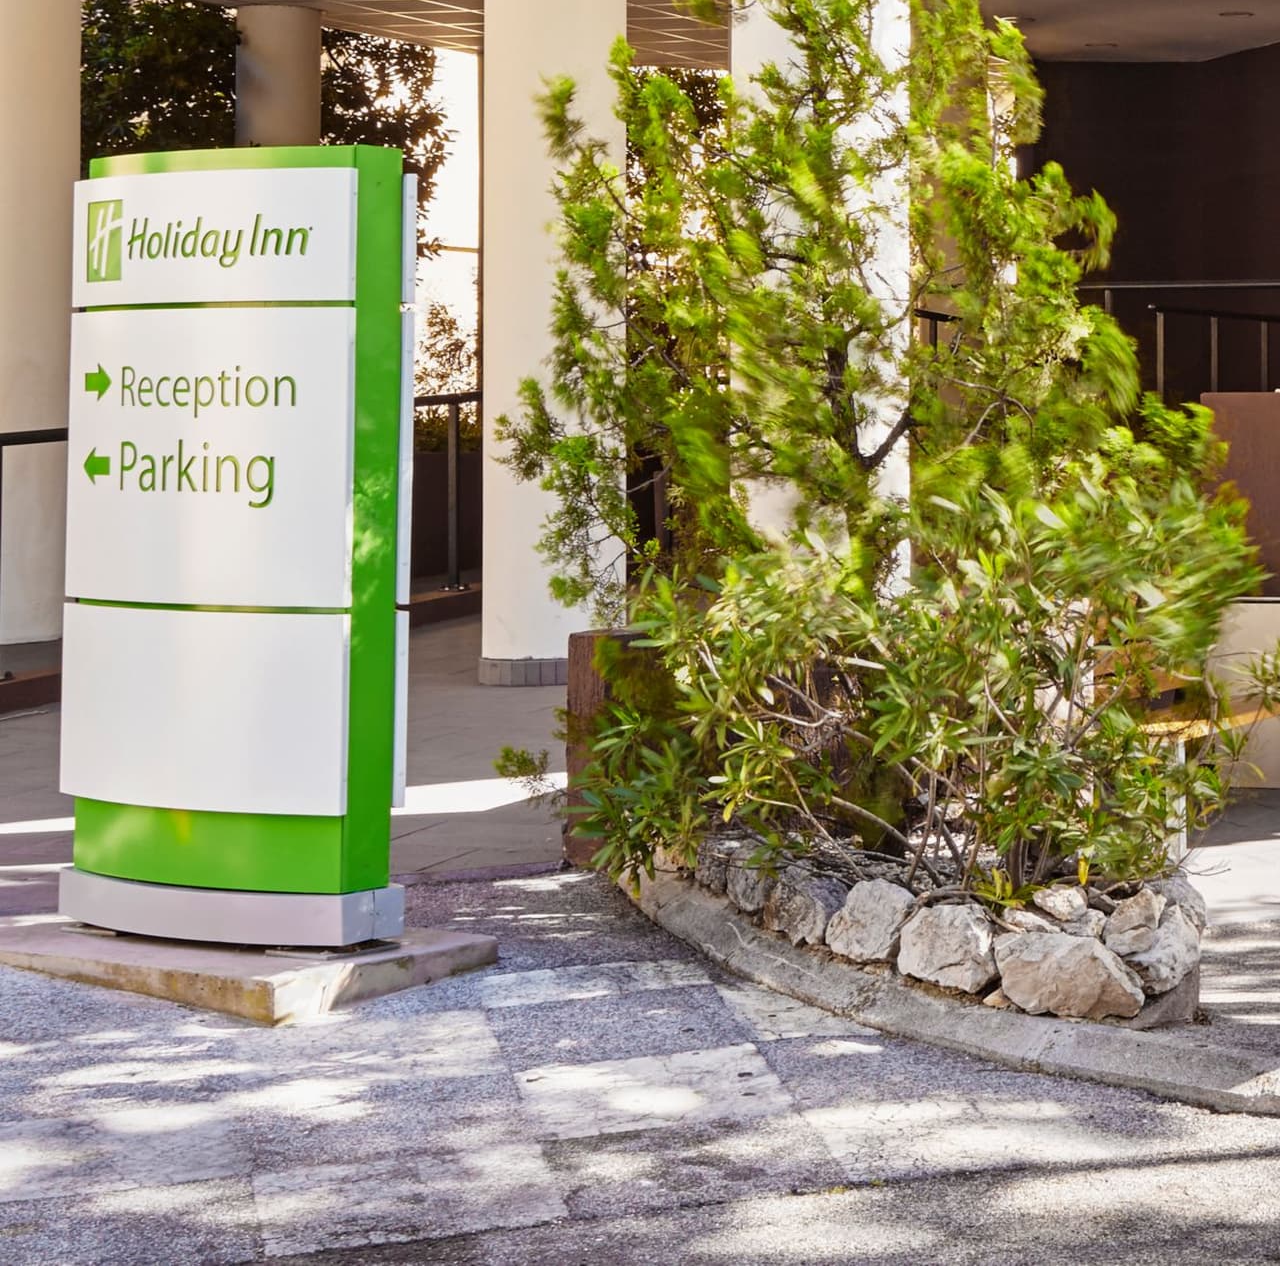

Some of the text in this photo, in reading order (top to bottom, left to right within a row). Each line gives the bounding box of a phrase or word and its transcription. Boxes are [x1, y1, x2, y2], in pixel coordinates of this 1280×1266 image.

[127, 213, 310, 268] Holiday Inn
[120, 365, 297, 419] Reception
[119, 439, 276, 509] Parking
